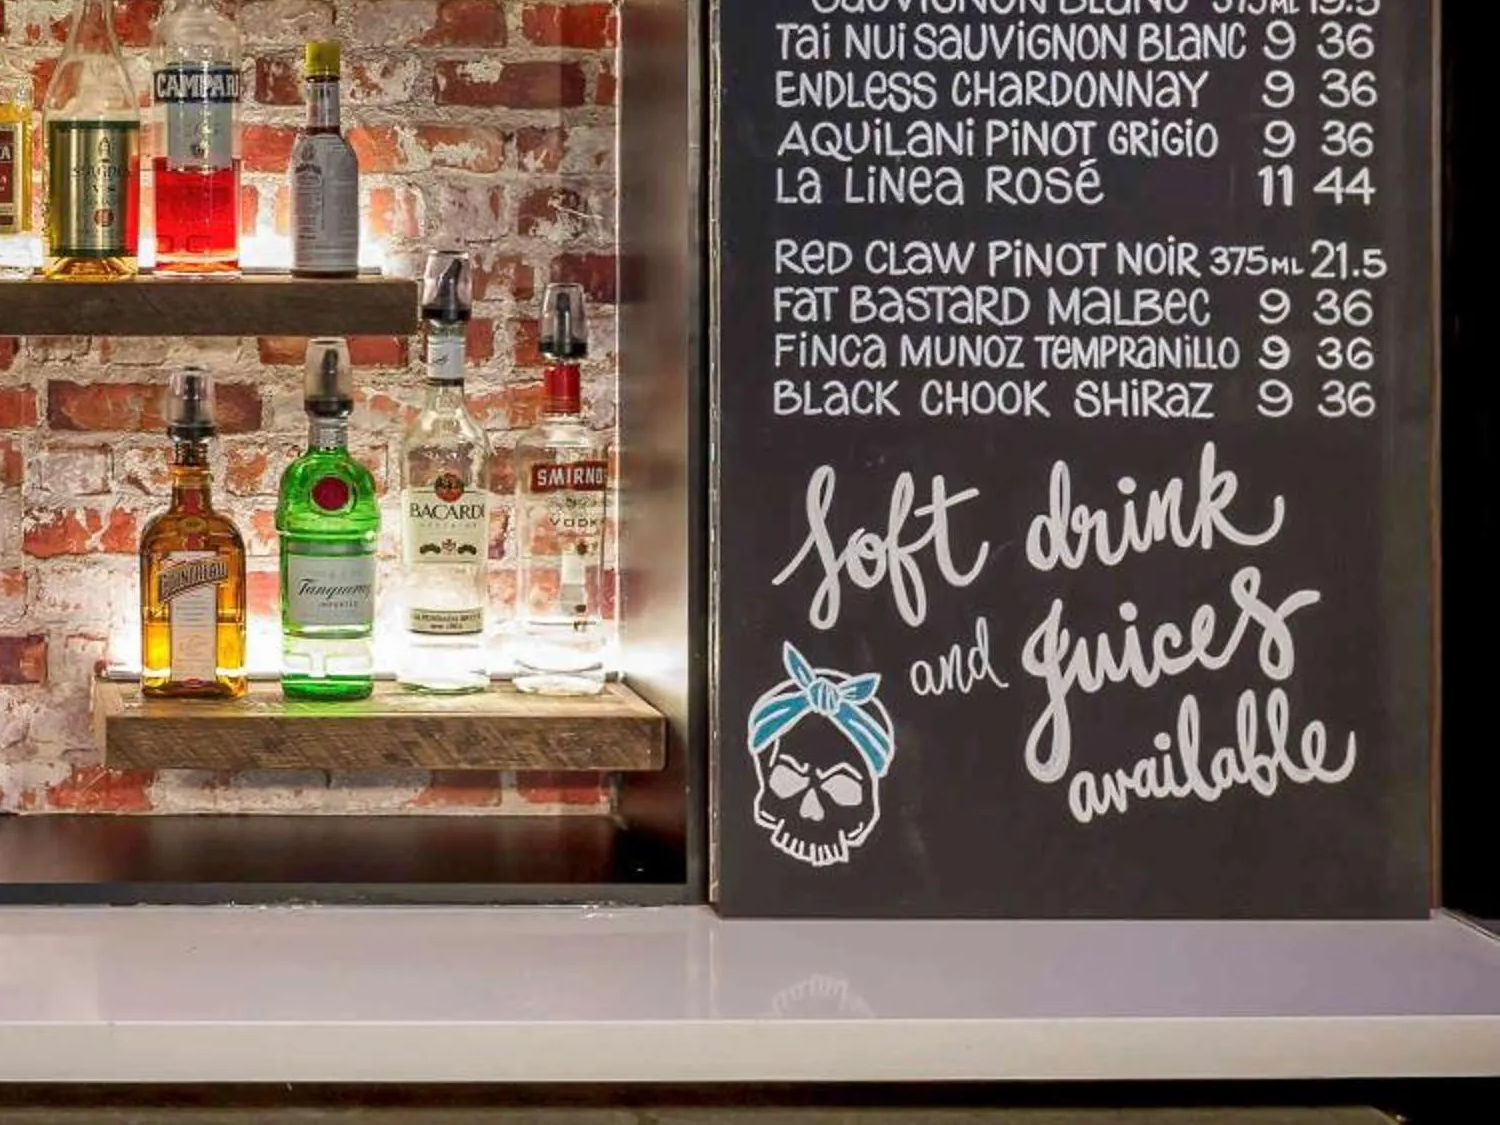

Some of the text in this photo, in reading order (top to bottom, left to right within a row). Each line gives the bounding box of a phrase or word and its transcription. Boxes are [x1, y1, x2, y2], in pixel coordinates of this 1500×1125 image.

[1263, 20, 1296, 60] 9
[1317, 21, 1374, 59] 36
[1262, 70, 1294, 108] 9
[1319, 69, 1377, 107] 36
[1263, 120, 1296, 158] 9
[1321, 120, 1373, 157] 36
[986, 158, 1104, 205] ROSÉ
[1258, 165, 1293, 206] 11
[1313, 166, 1376, 205] 44
[1311, 239, 1387, 280] 21.5
[1259, 288, 1290, 324] 9
[1313, 289, 1373, 326] 36
[901, 334, 1025, 368] MUNOZ
[1259, 335, 1290, 370] 9
[1316, 337, 1374, 370] 36
[921, 380, 1050, 417] CHOOK
[1257, 379, 1293, 417] 9
[1318, 380, 1375, 417] 36
[537, 466, 604, 487] SMIRNO
[772, 441, 1284, 632] Soft drink
[910, 616, 1009, 695] and
[1068, 689, 1356, 823] available
